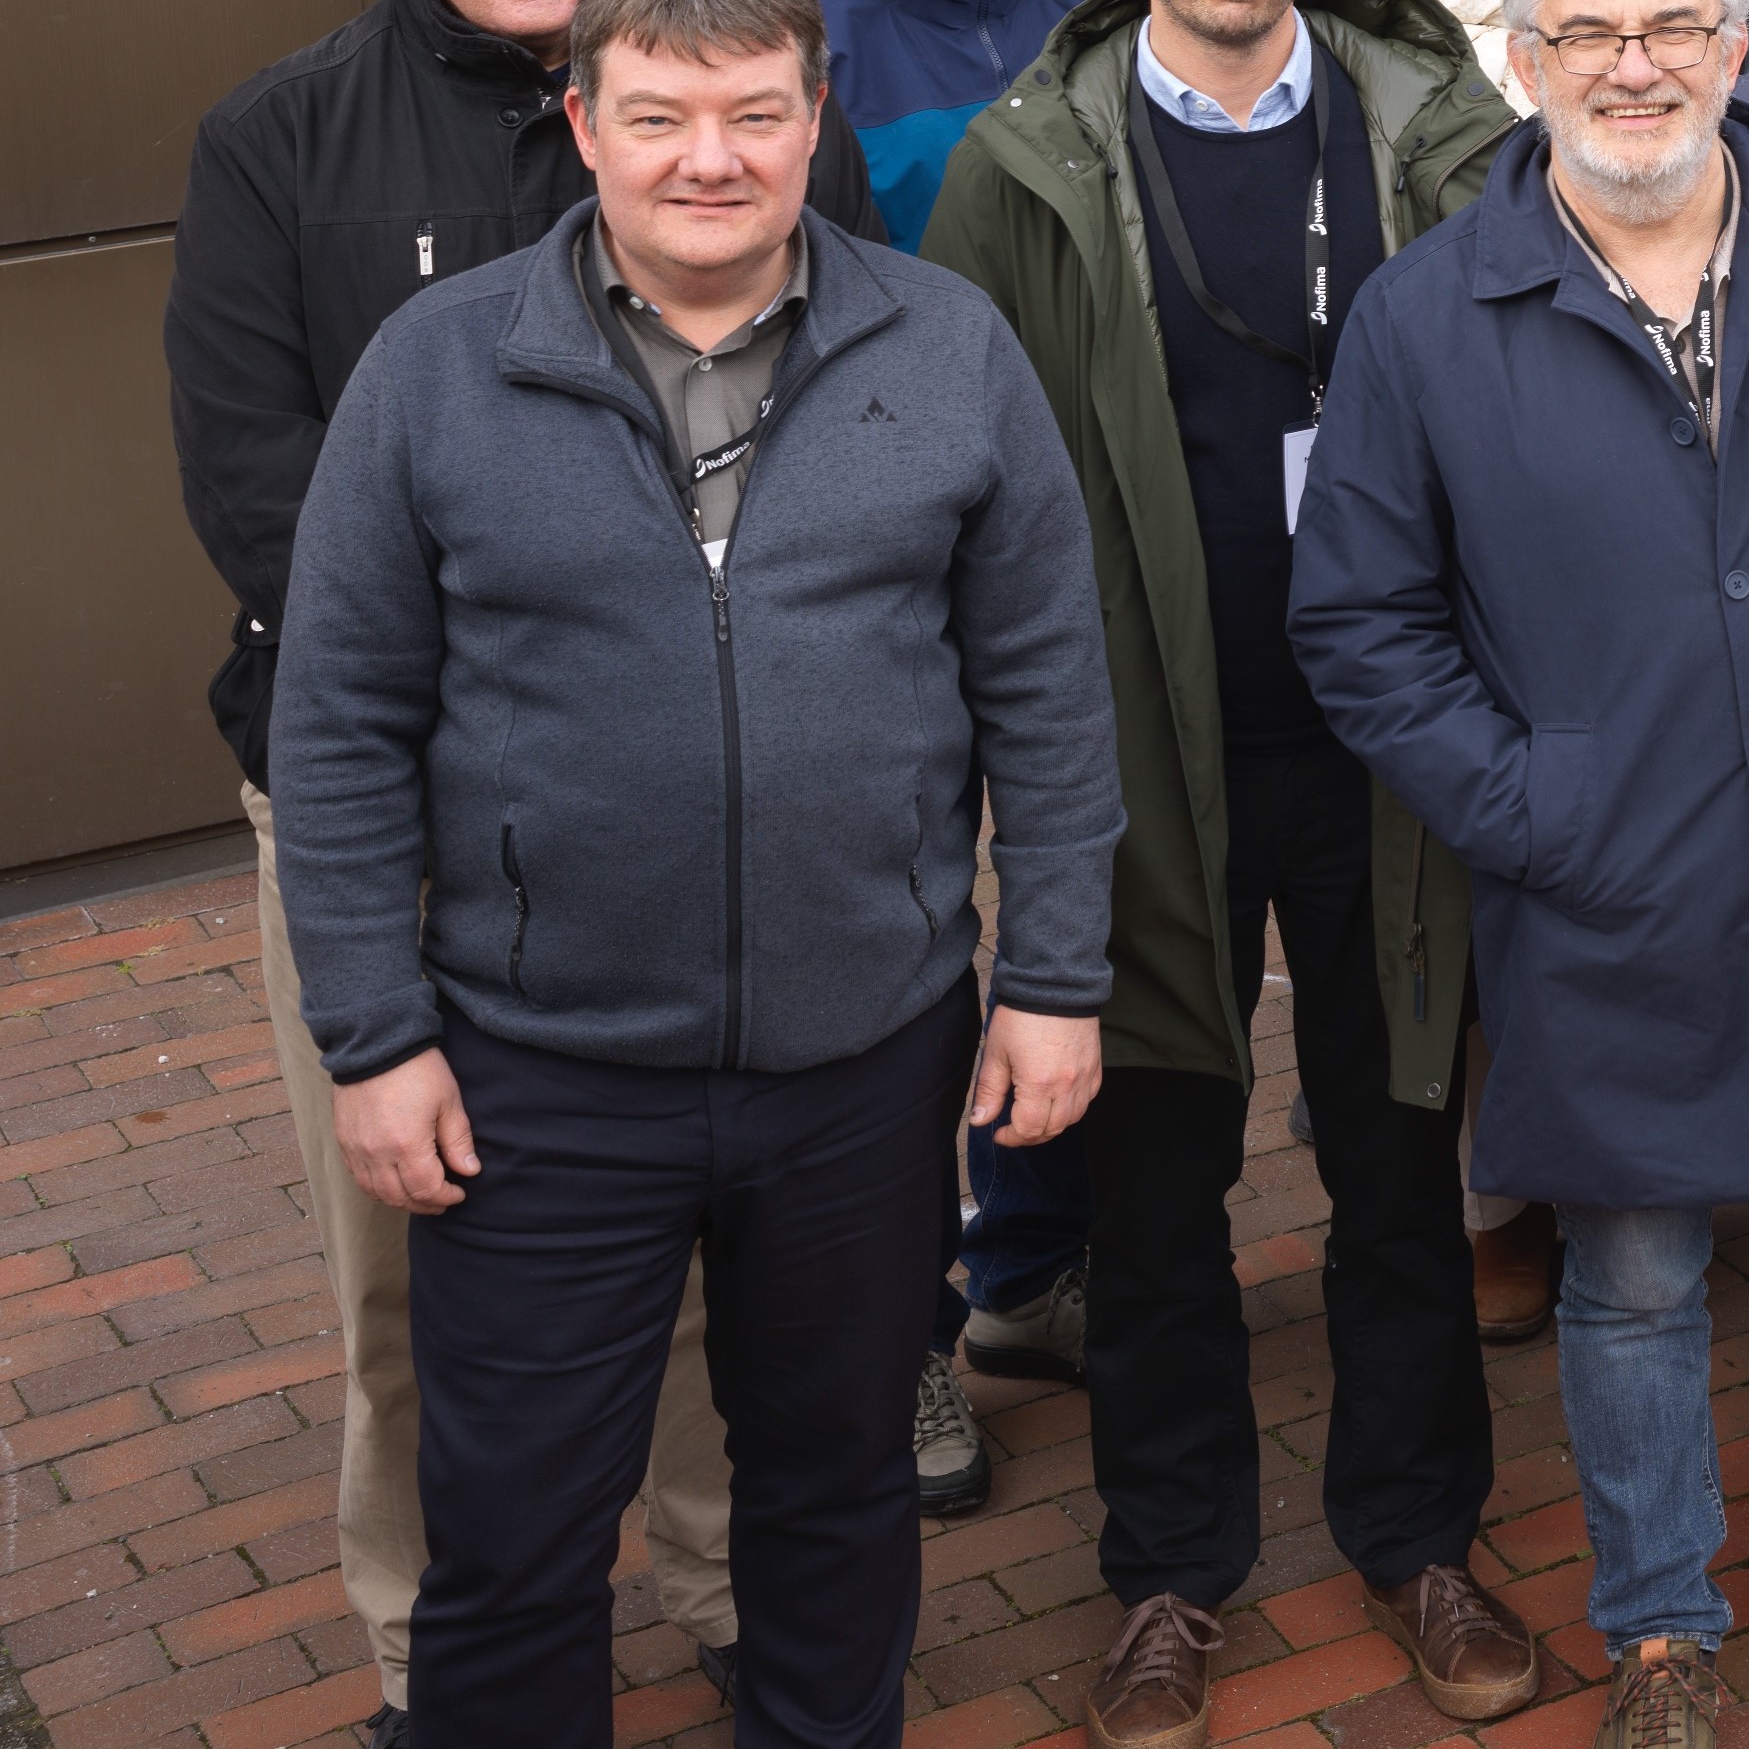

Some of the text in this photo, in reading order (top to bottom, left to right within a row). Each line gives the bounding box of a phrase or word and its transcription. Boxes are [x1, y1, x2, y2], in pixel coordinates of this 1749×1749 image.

[1314, 178, 1325, 223] Nofima
[1314, 266, 1327, 312] Nofima
[1698, 309, 1711, 352] Nofima
[1652, 332, 1678, 376] Nofima
[705, 441, 751, 472] Nofima
